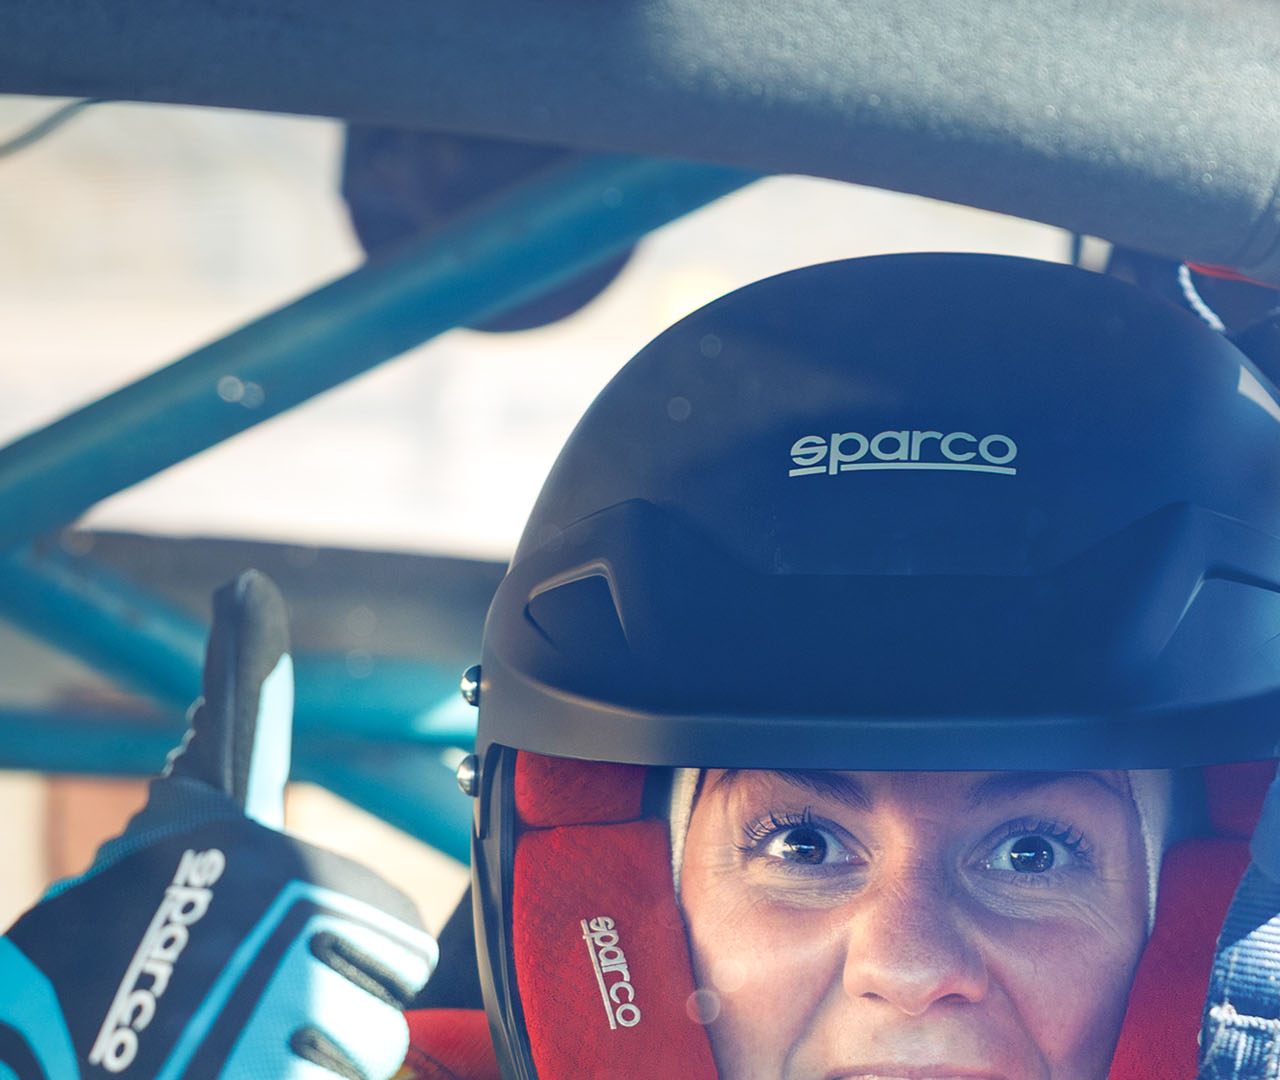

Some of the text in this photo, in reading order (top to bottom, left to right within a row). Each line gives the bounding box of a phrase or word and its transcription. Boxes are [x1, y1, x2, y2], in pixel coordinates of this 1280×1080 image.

[788, 430, 1018, 477] sparco
[88, 847, 226, 1074] sparco
[580, 916, 641, 1029] sparco
